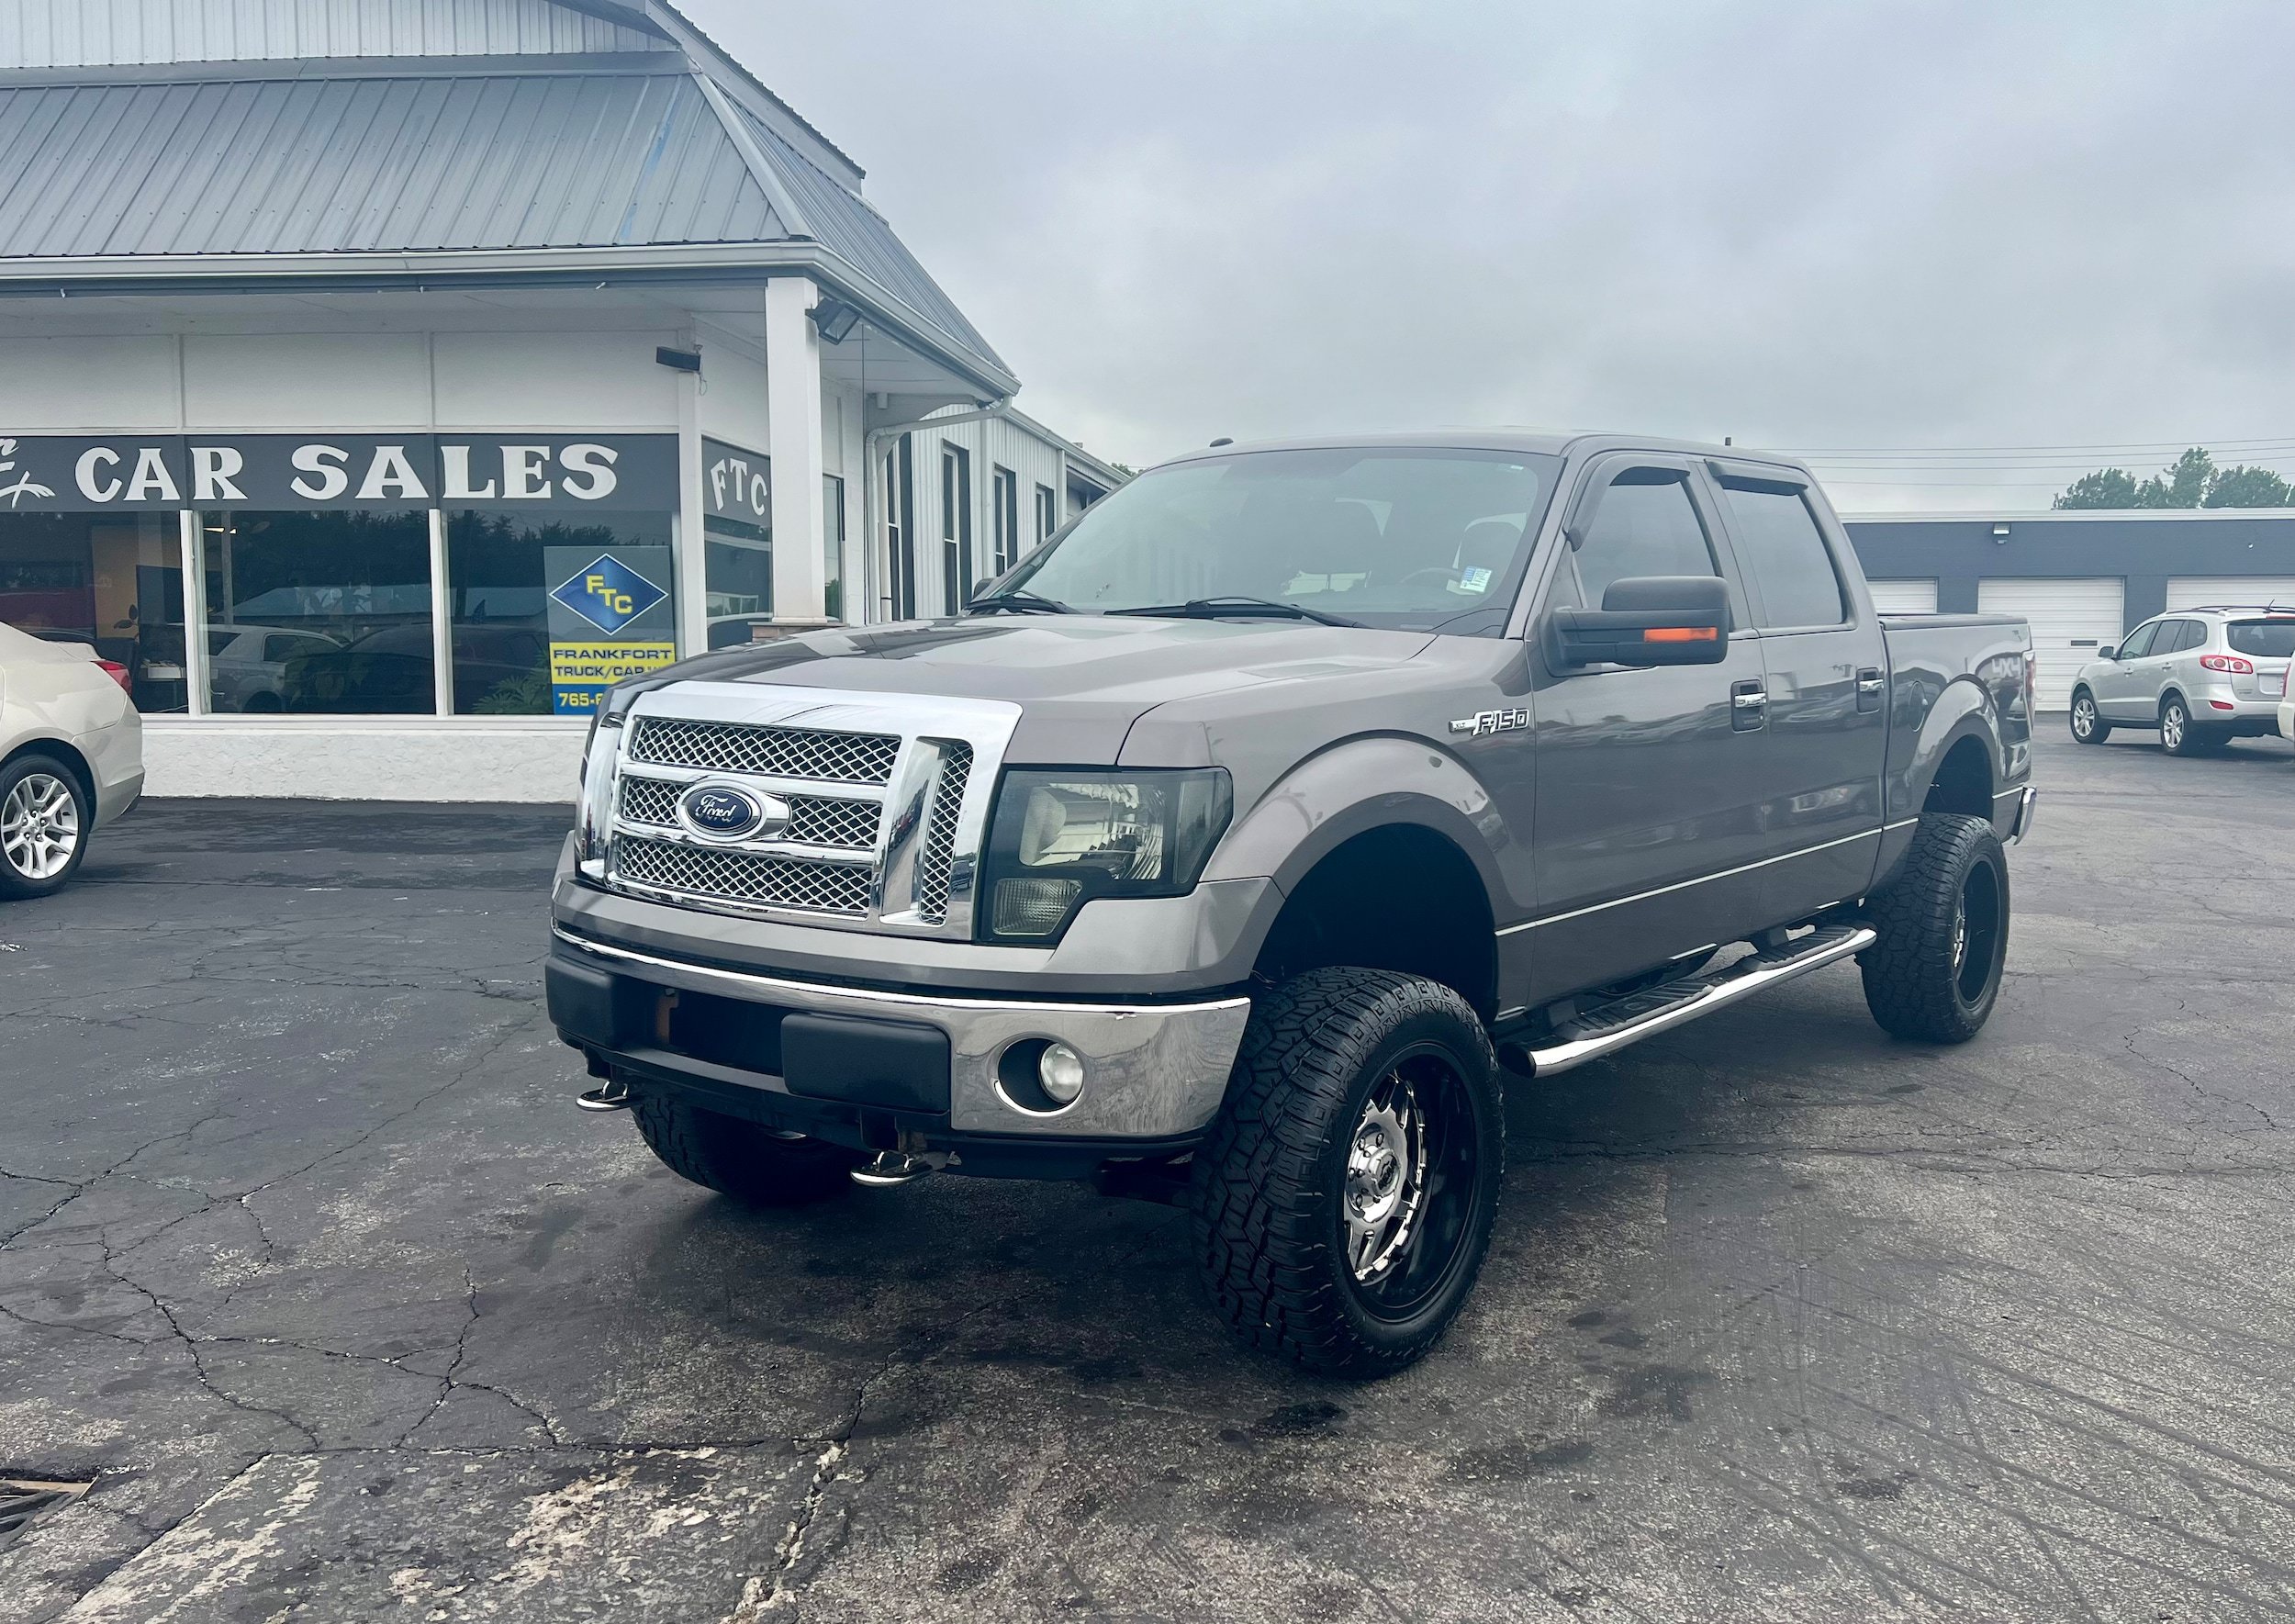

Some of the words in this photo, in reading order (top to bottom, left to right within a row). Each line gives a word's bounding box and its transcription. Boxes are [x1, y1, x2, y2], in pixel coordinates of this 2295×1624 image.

[74, 446, 248, 503] CAR
[290, 442, 618, 500] SALES
[711, 457, 767, 515] FTC
[586, 575, 633, 614] FTC
[554, 649, 672, 659] FRANKFORT
[696, 795, 737, 817] Ford
